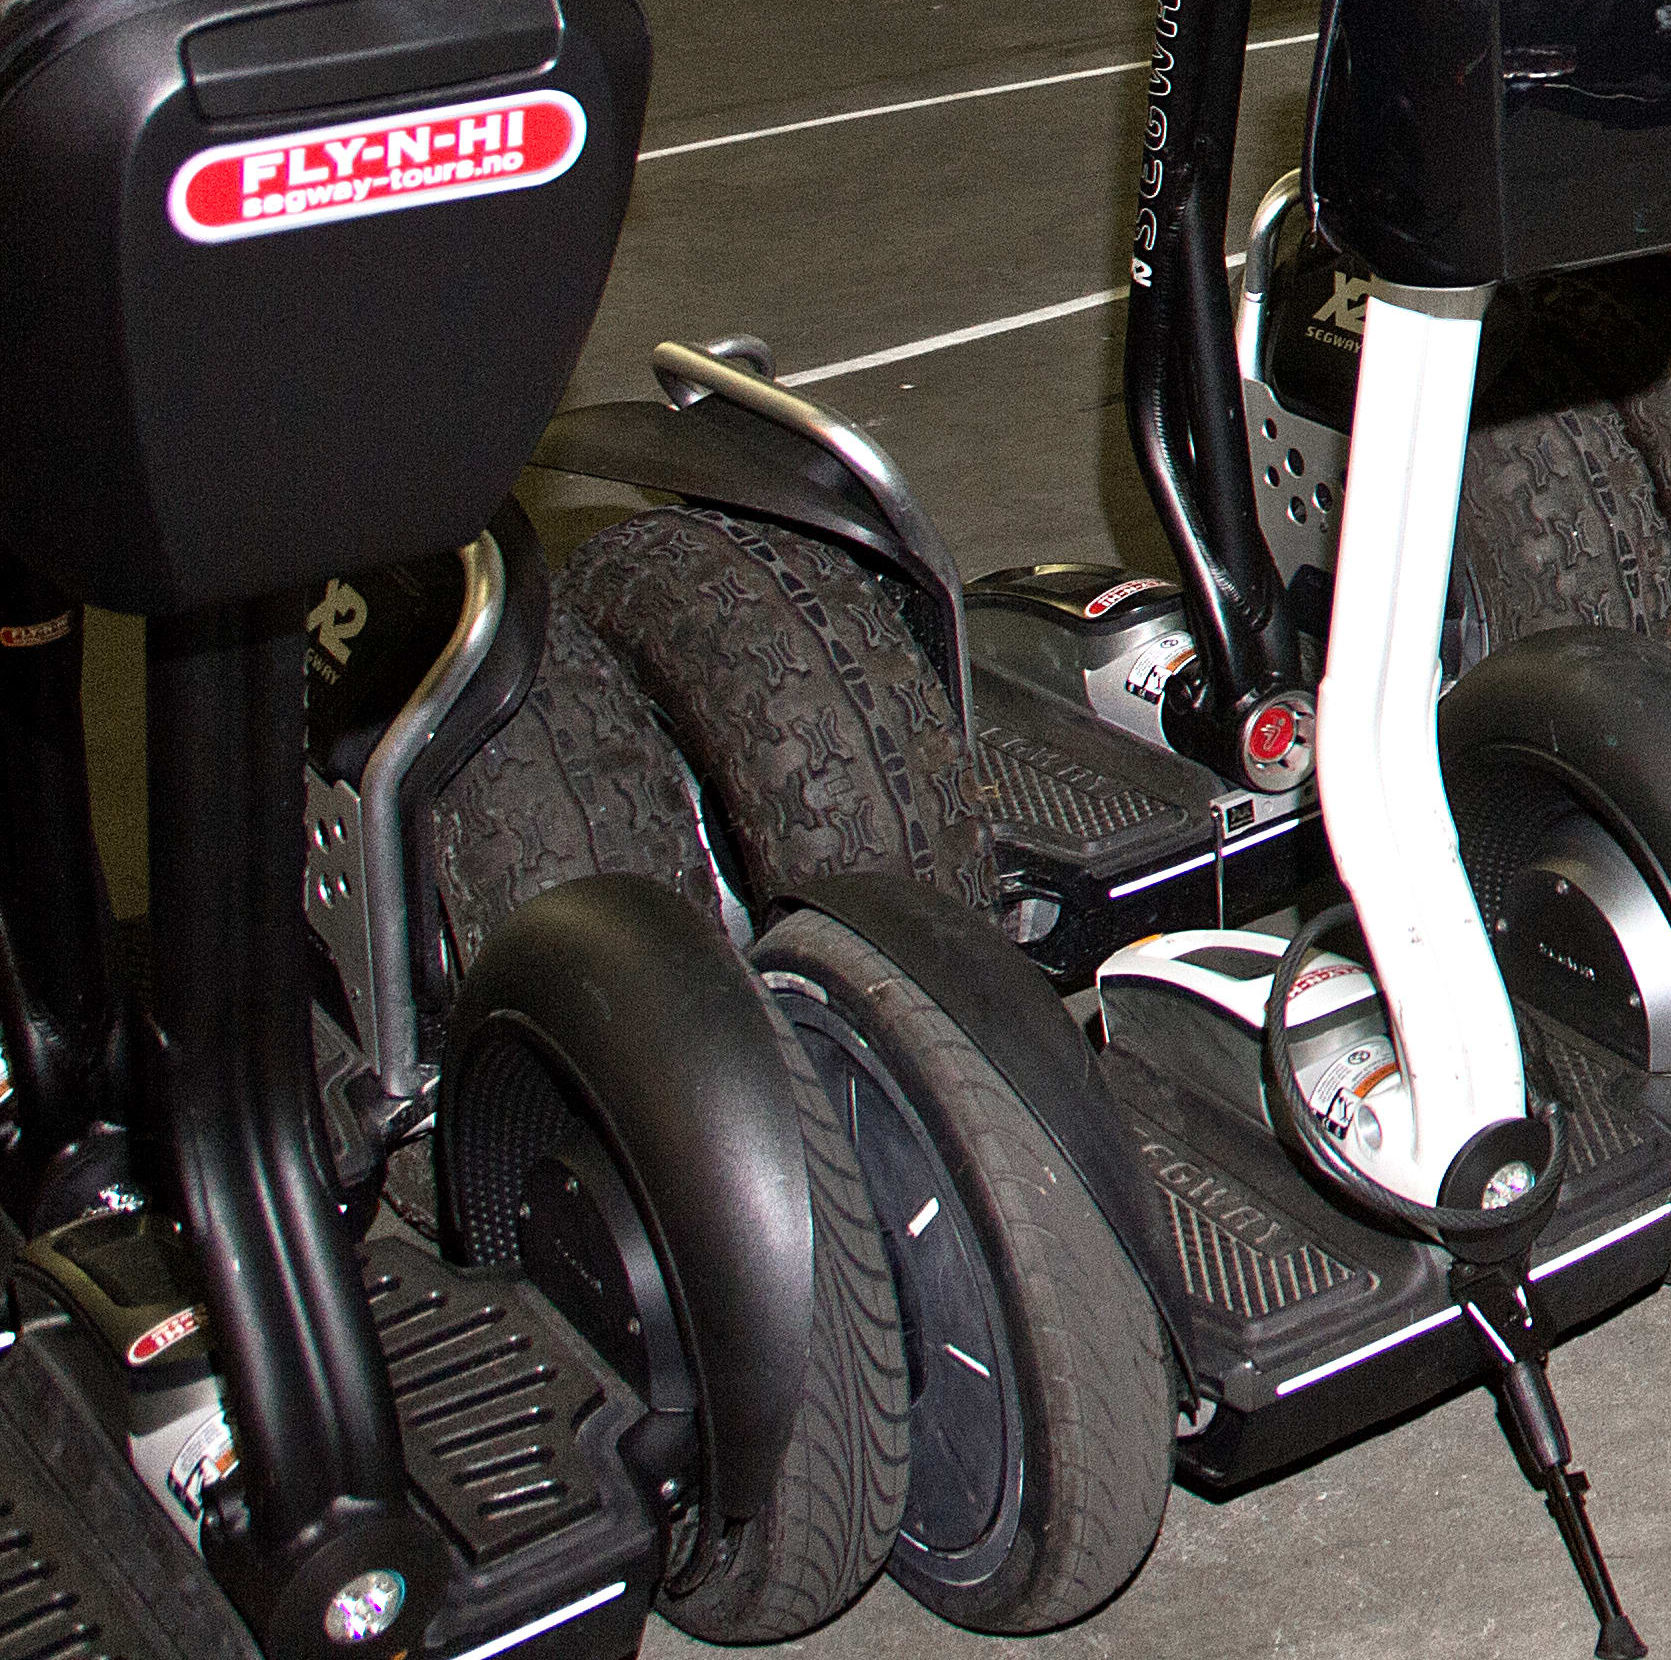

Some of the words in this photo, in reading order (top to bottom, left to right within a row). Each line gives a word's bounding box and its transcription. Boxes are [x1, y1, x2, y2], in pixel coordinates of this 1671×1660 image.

[242, 110, 524, 194] FLY-N-HI
[242, 151, 524, 218] segway-tours.no
[1304, 325, 1363, 354] SEGWAY
